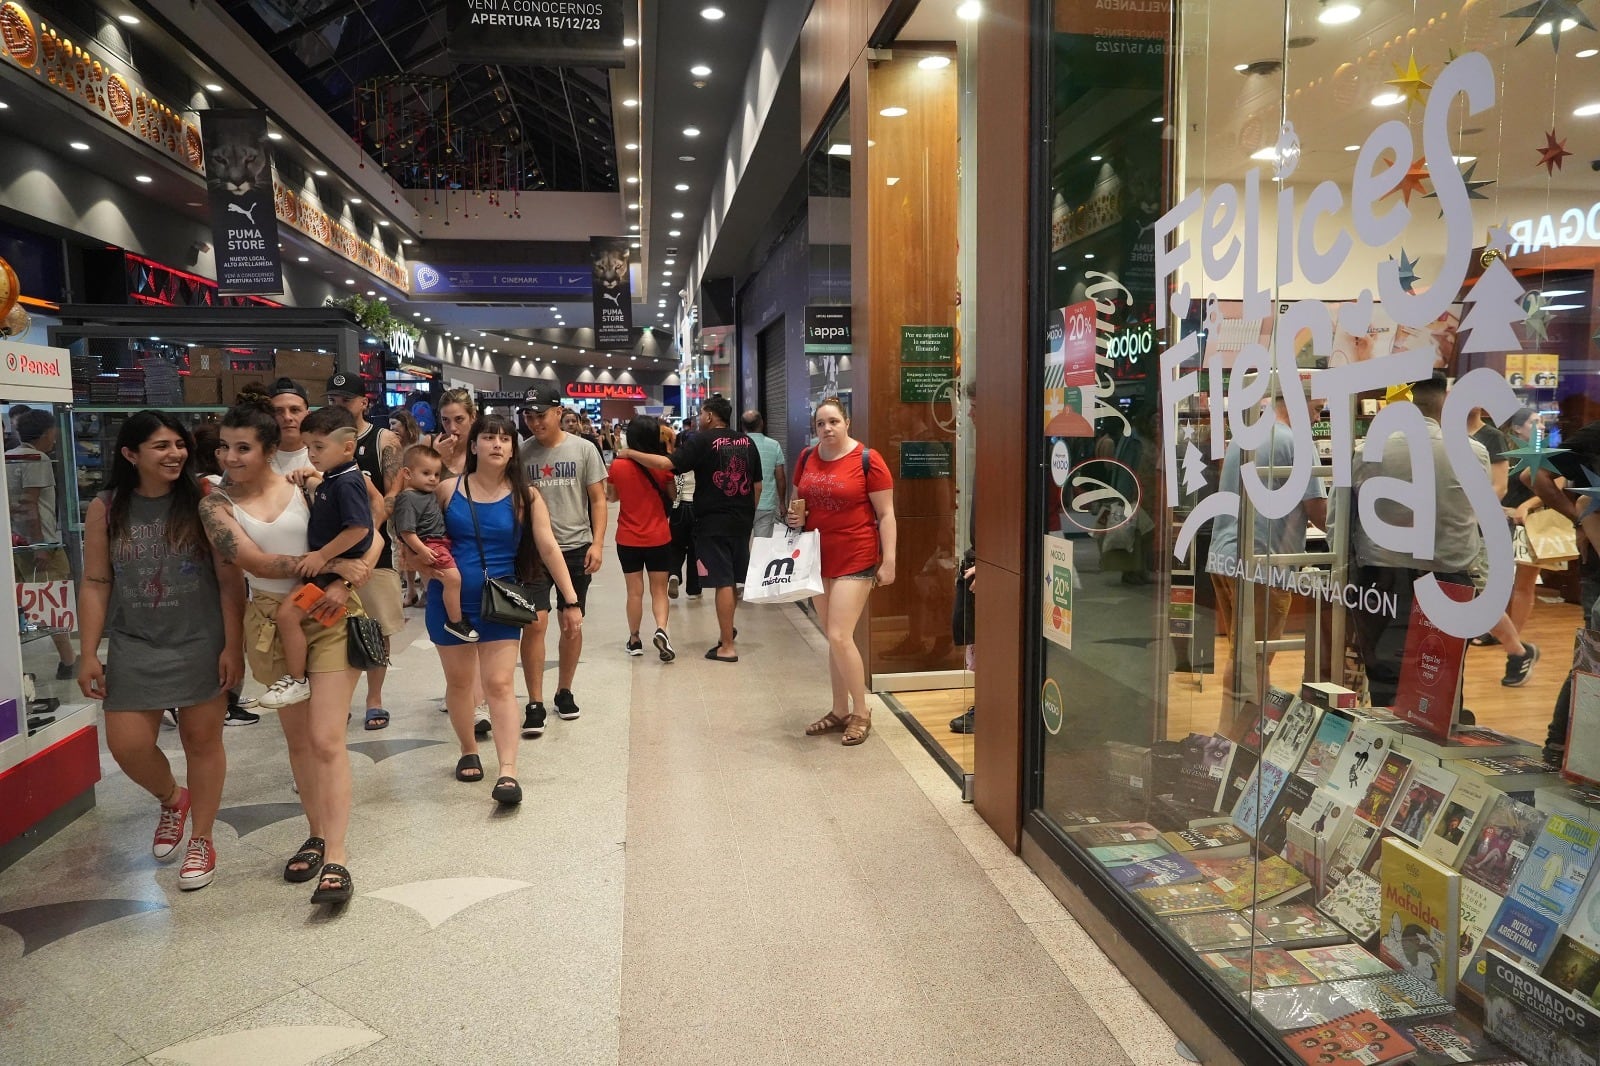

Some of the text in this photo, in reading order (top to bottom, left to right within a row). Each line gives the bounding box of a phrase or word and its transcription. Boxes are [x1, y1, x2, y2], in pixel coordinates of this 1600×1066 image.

[501, 0, 510, 11] A
[513, 1, 603, 15] CONOCERNOS
[471, 13, 601, 30] APERTURA 15/12/23
[228, 229, 263, 240] PUMA
[227, 240, 266, 250] STORE
[20, 354, 60, 377] Pensel
[566, 383, 648, 399] CINEMARK
[555, 461, 577, 478] STAR
[761, 576, 792, 588] mistral
[1207, 551, 1265, 585] REGALÁ
[1267, 566, 1398, 620] IMAGINACIÓN
[1402, 881, 1422, 898] TODA
[1386, 882, 1441, 931] Mafalda
[1460, 907, 1476, 923] 024
[1510, 919, 1533, 938] RUTAS
[1497, 924, 1537, 953] ARGENTINAS
[1496, 965, 1586, 1028] CORONADOS
[1512, 987, 1565, 1026] DE GLORIA
